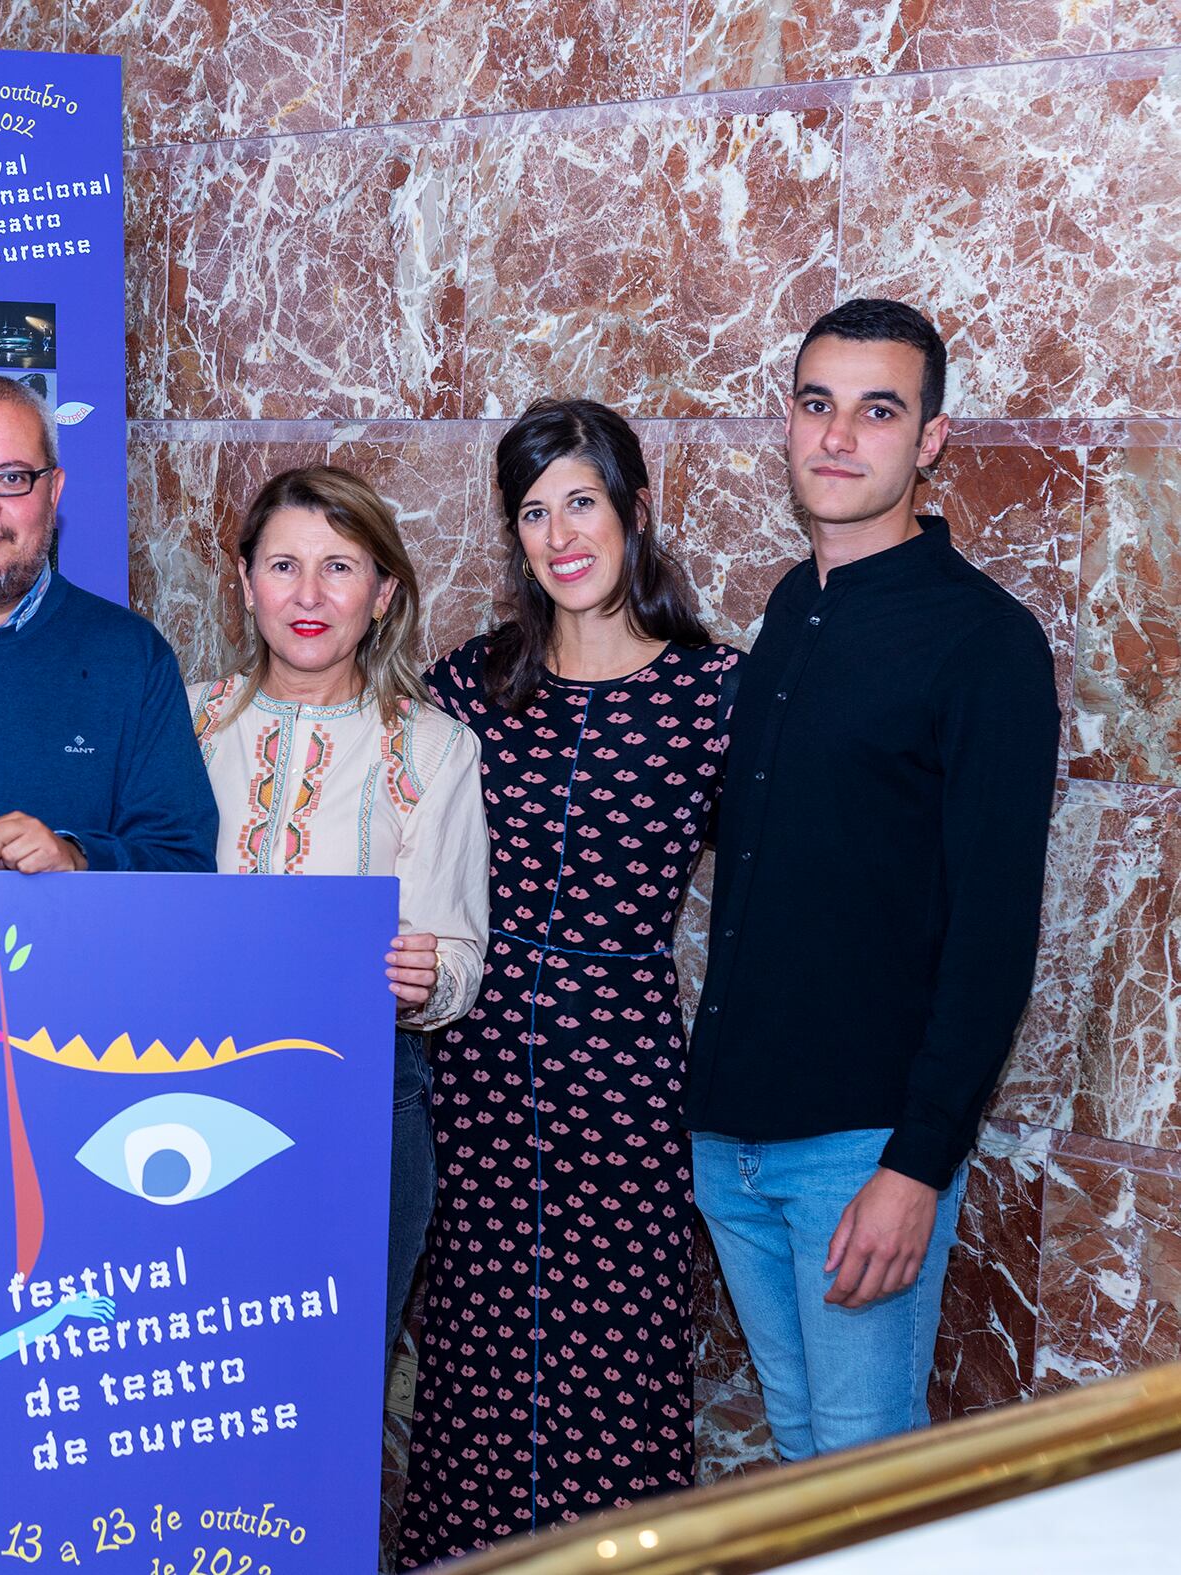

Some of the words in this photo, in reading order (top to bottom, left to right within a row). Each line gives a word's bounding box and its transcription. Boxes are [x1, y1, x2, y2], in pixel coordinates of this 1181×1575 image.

[54, 407, 89, 424] ESTREA
[64, 745, 95, 754] GANT
[7, 1245, 188, 1313] festival
[16, 1274, 339, 1366] internacional
[24, 1376, 81, 1418] de
[99, 1355, 246, 1407] teatro
[32, 1430, 89, 1471] de
[108, 1401, 299, 1459] ourense
[0, 1521, 43, 1564] 13
[58, 1540, 81, 1566] a
[92, 1507, 136, 1555] 23
[150, 1503, 183, 1542] de
[199, 1502, 307, 1546] outubro
